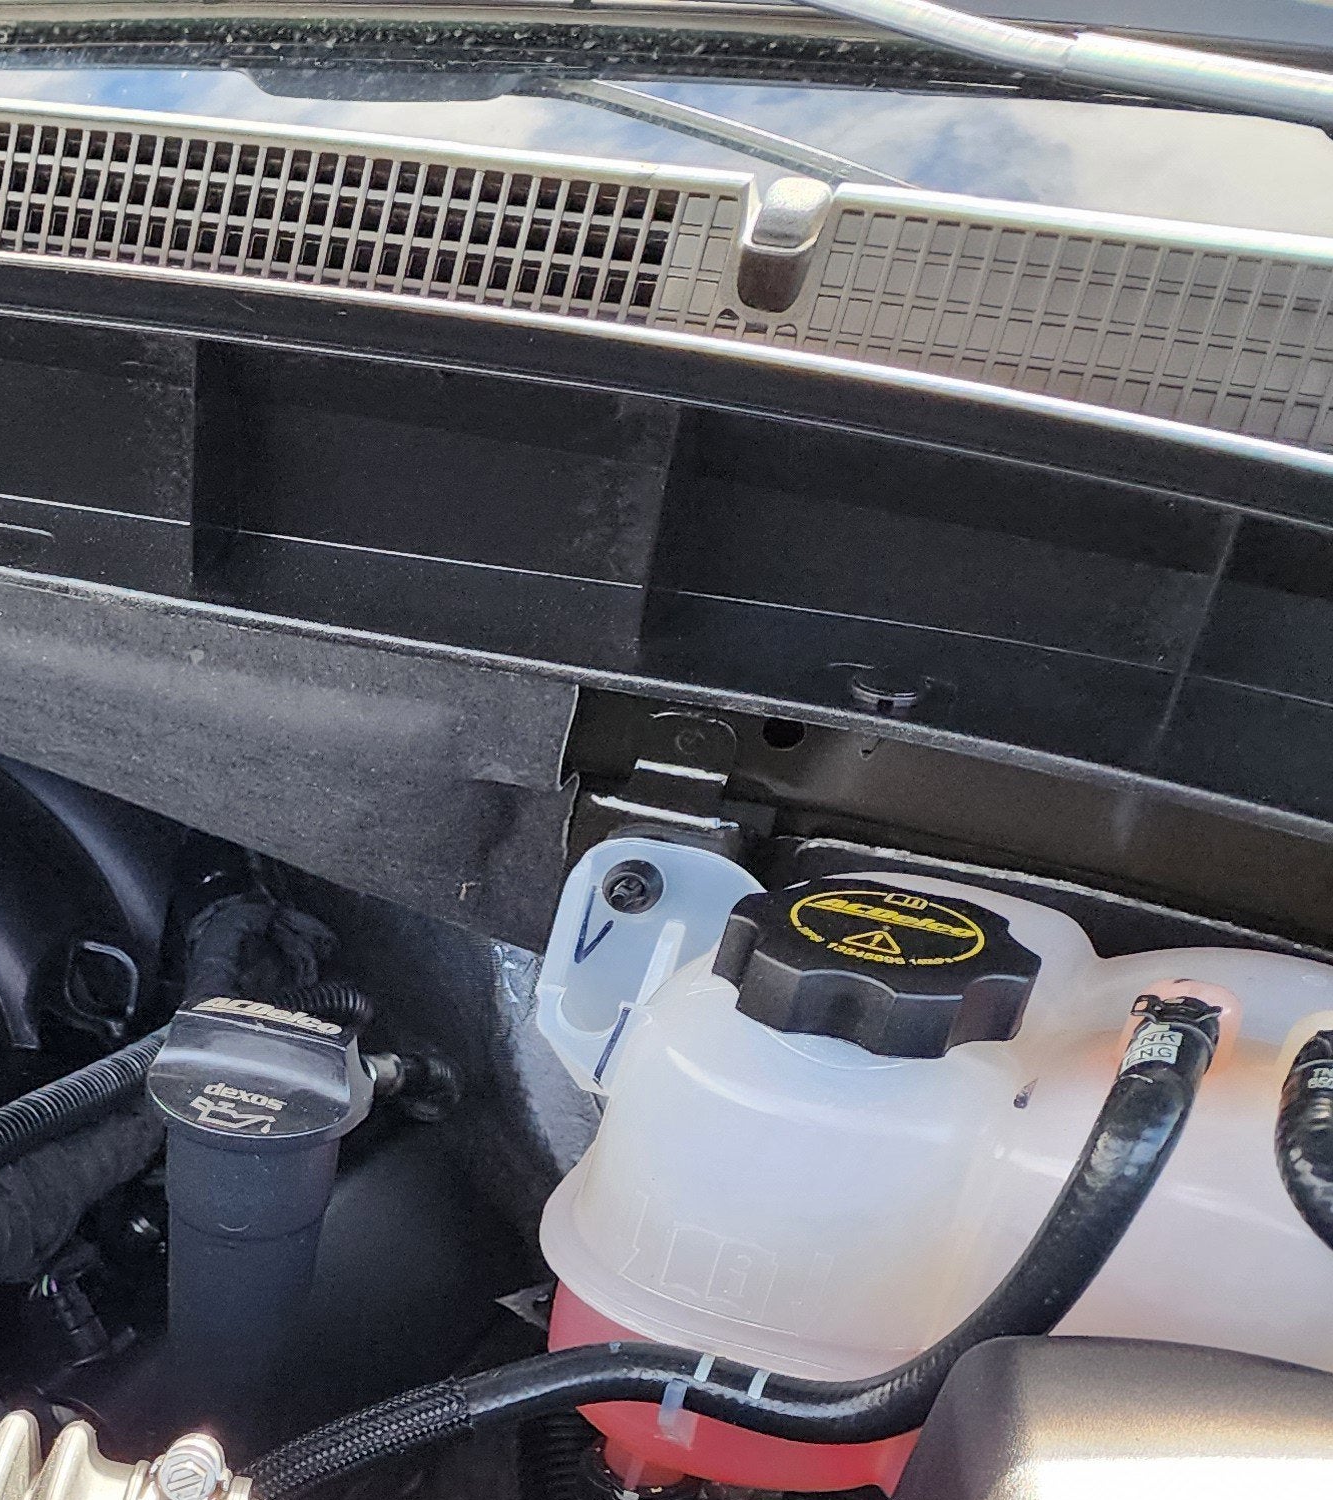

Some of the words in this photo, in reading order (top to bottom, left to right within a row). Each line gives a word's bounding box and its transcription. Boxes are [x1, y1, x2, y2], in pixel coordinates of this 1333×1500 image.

[804, 899, 977, 938] ACDelco
[192, 997, 342, 1036] ACDelco
[203, 1082, 288, 1111] dexos
